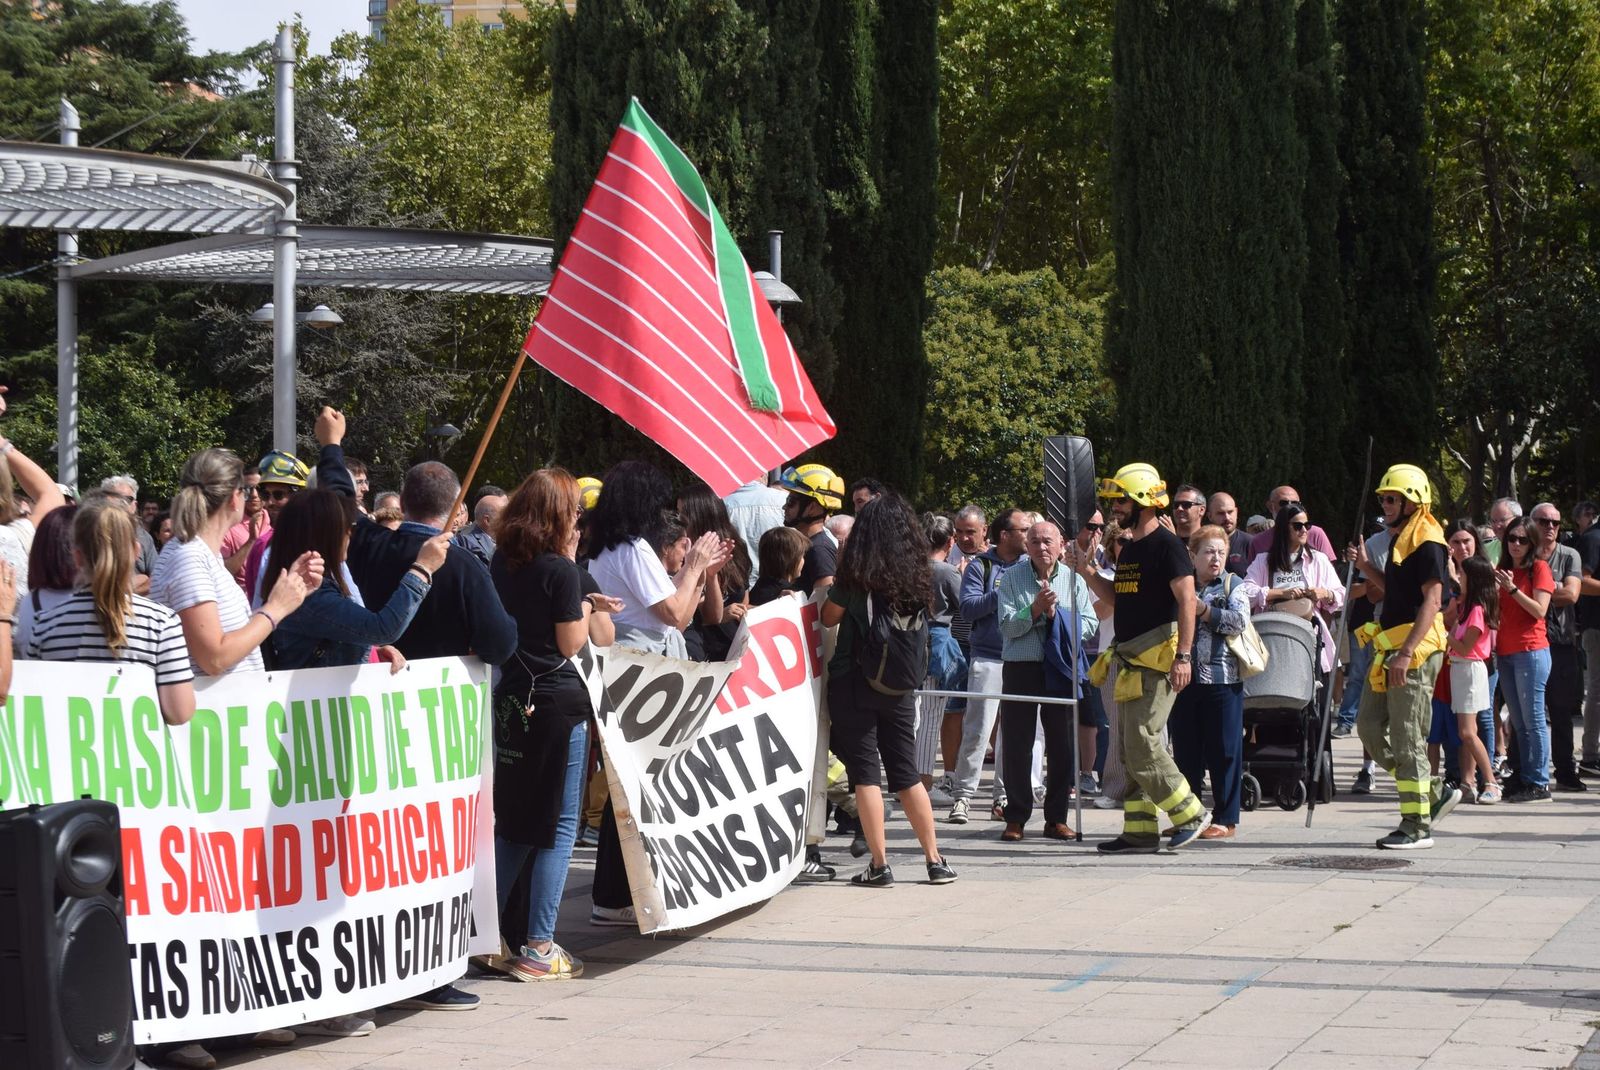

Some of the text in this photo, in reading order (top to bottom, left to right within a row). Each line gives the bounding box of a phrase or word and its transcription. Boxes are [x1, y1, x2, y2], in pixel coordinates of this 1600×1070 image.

[0, 694, 54, 812] NA
[67, 676, 190, 811] BÁSI
[190, 705, 251, 814] DE
[265, 695, 378, 808] SALUD
[381, 690, 418, 790] DE
[645, 711, 804, 826] JUNTA
[159, 823, 303, 916] SADAD
[312, 798, 449, 901] PÚBLICA
[199, 926, 323, 1016] RURALES
[333, 914, 386, 994] SIN
[395, 900, 444, 981] CITA
